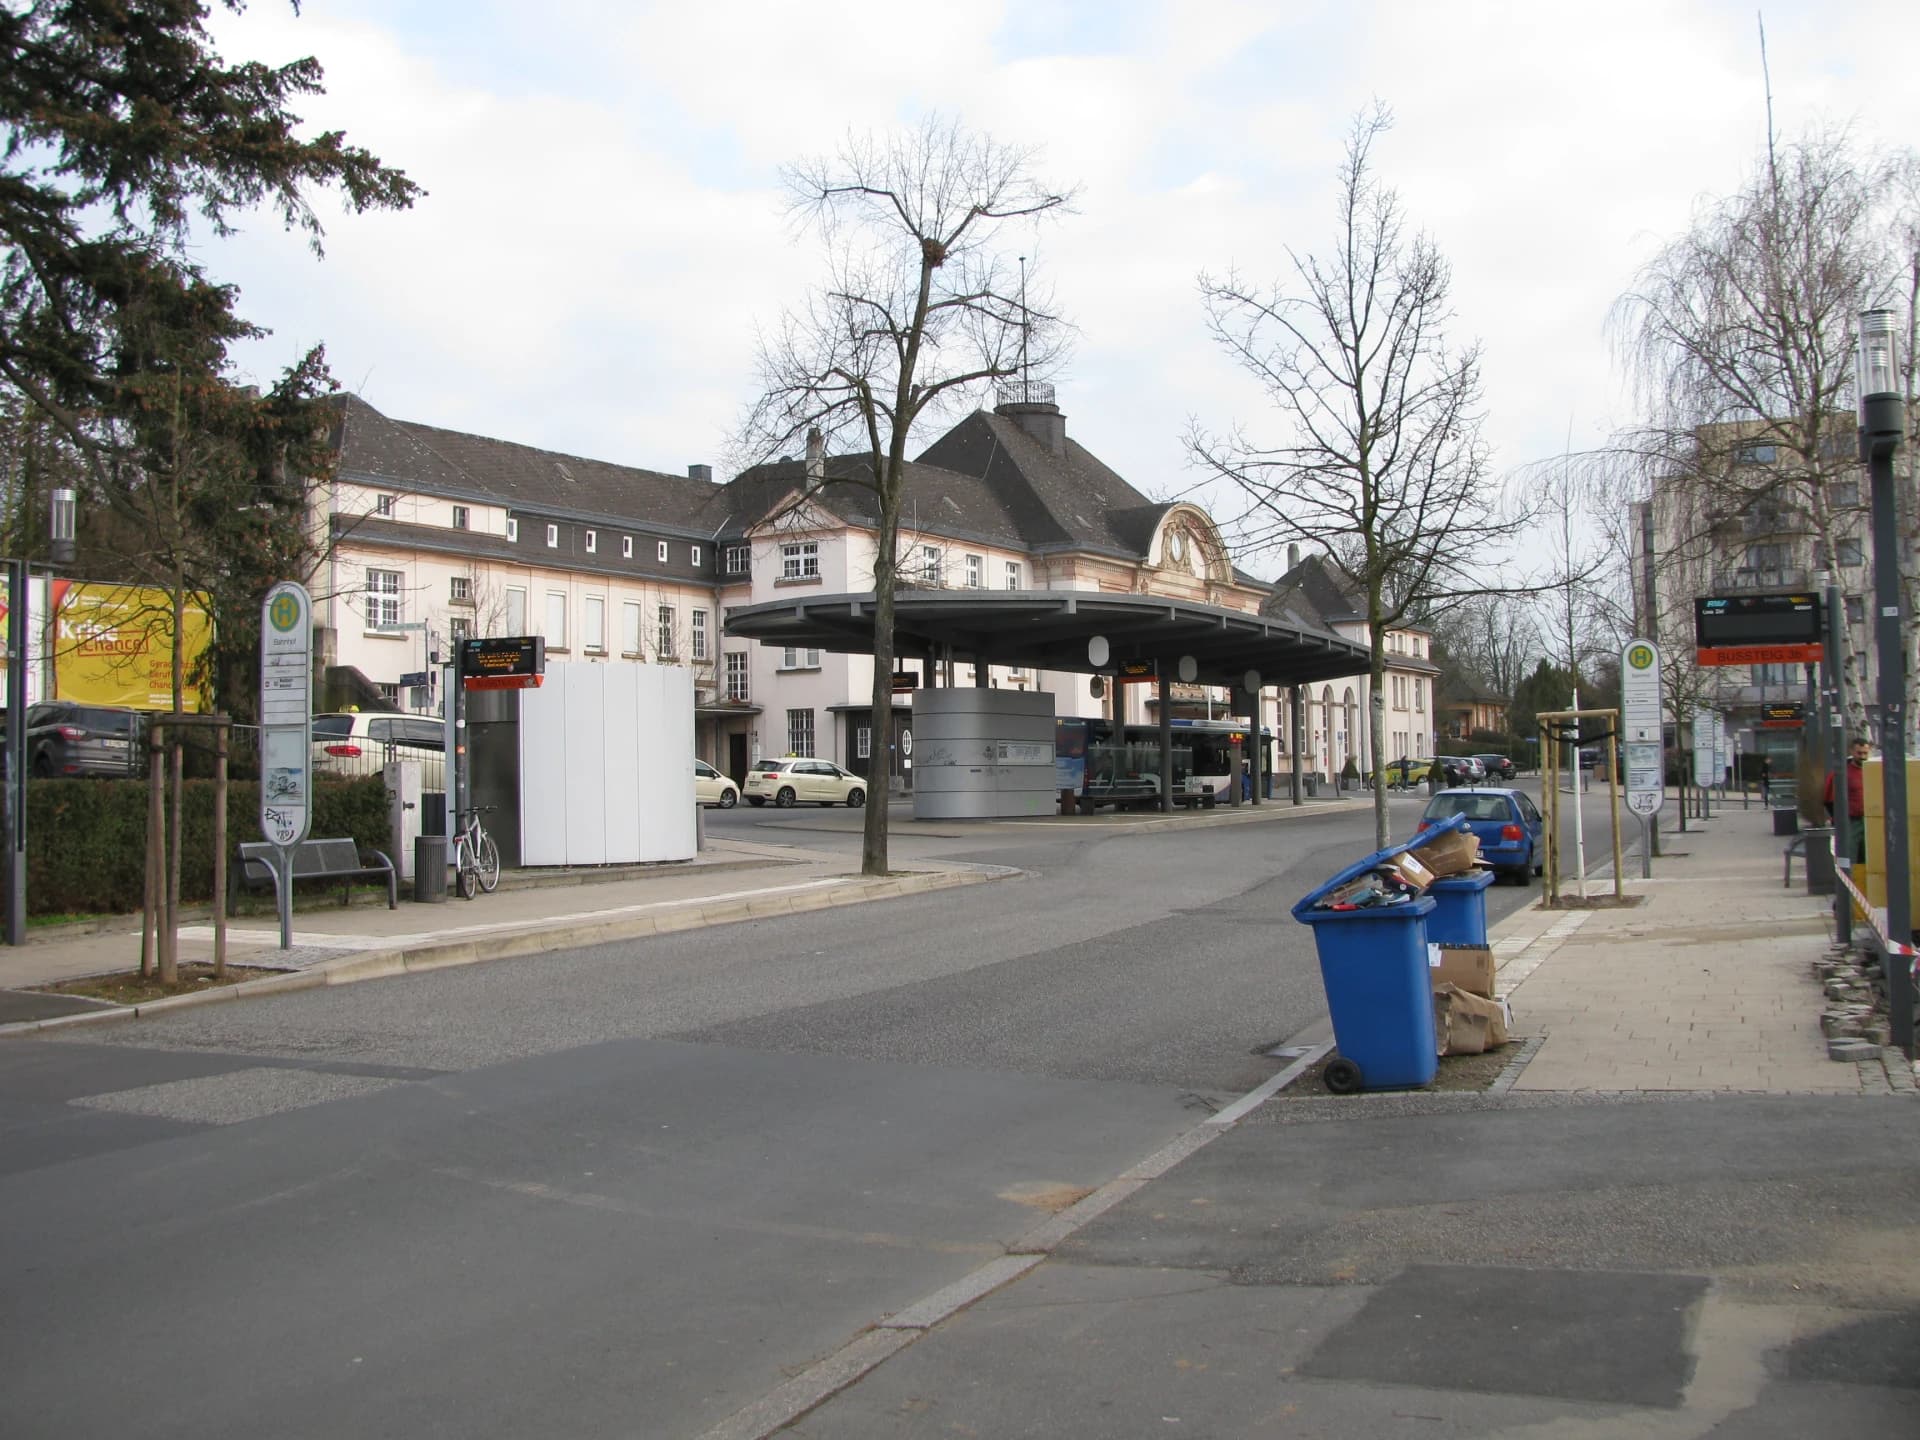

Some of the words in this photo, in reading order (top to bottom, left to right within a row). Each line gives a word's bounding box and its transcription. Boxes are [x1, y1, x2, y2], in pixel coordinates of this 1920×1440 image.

[60, 619, 119, 642] Krise
[84, 637, 142, 653] Chance
[1717, 649, 1783, 662] BUSSTEIG
